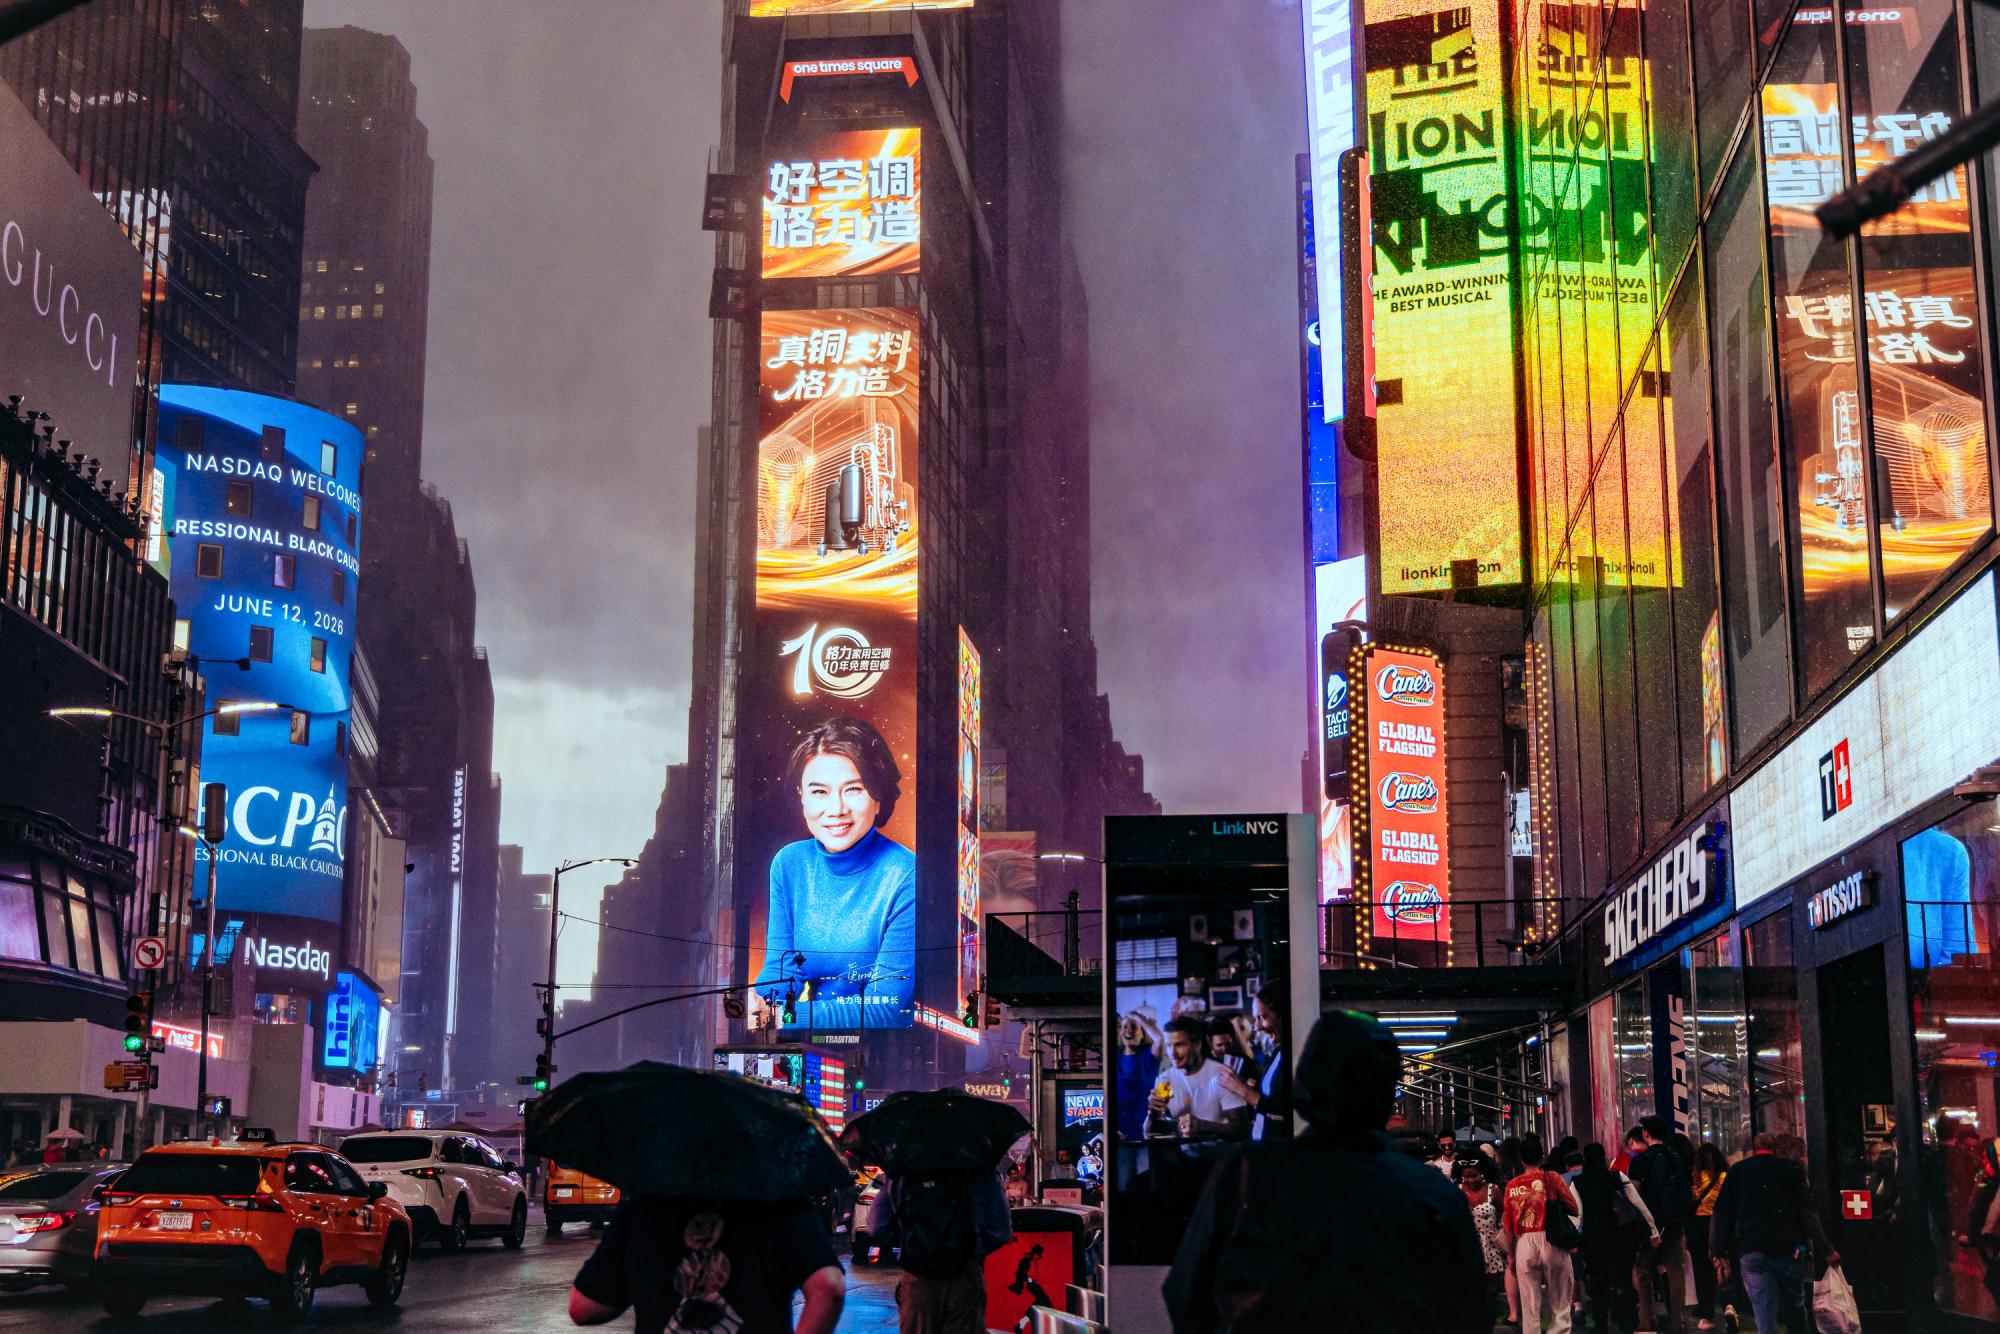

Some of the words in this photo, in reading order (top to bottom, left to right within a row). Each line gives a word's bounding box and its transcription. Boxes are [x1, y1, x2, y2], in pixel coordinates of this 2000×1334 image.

[793, 62, 817, 74] one
[819, 60, 855, 73] times
[857, 59, 902, 74] square
[768, 157, 915, 204] 好空调
[769, 202, 917, 248] 格力造
[1390, 299, 1422, 313] BEST
[1427, 289, 1492, 309] MUSICAL
[1391, 273, 1509, 299] AWARD-WINNIN
[2, 221, 117, 387] GUCCI
[767, 329, 913, 373] 真铜实料
[773, 366, 908, 401] 格力造
[186, 453, 283, 483] NASDAQ
[291, 468, 361, 513] WELCOMES
[175, 519, 284, 547] RESSIONAL
[289, 533, 334, 561] BLACK
[214, 593, 273, 617] JUNE
[282, 603, 307, 627] 12,
[314, 611, 344, 636] 2026
[825, 645, 892, 661] 格力家用空调
[1379, 665, 1435, 700] Cane's
[1326, 709, 1348, 727] TACO
[1327, 722, 1348, 739] BELL
[1378, 720, 1436, 744] GLOBAL
[1378, 738, 1437, 758] FLAGSHIP
[1381, 773, 1438, 809] Cane's
[1212, 820, 1279, 836] LinkNYC
[1381, 828, 1438, 851] GLOBAL
[271, 854, 308, 871] BLACK
[1381, 847, 1439, 866] FLAGSHIP
[1385, 880, 1441, 919] Cane's
[1604, 822, 1709, 967] SKECHERS
[1822, 871, 1863, 923] TISSOT
[244, 936, 331, 981] Nasdaq
[1067, 1095, 1094, 1107] NEW
[1067, 1107, 1104, 1117] STARTS
